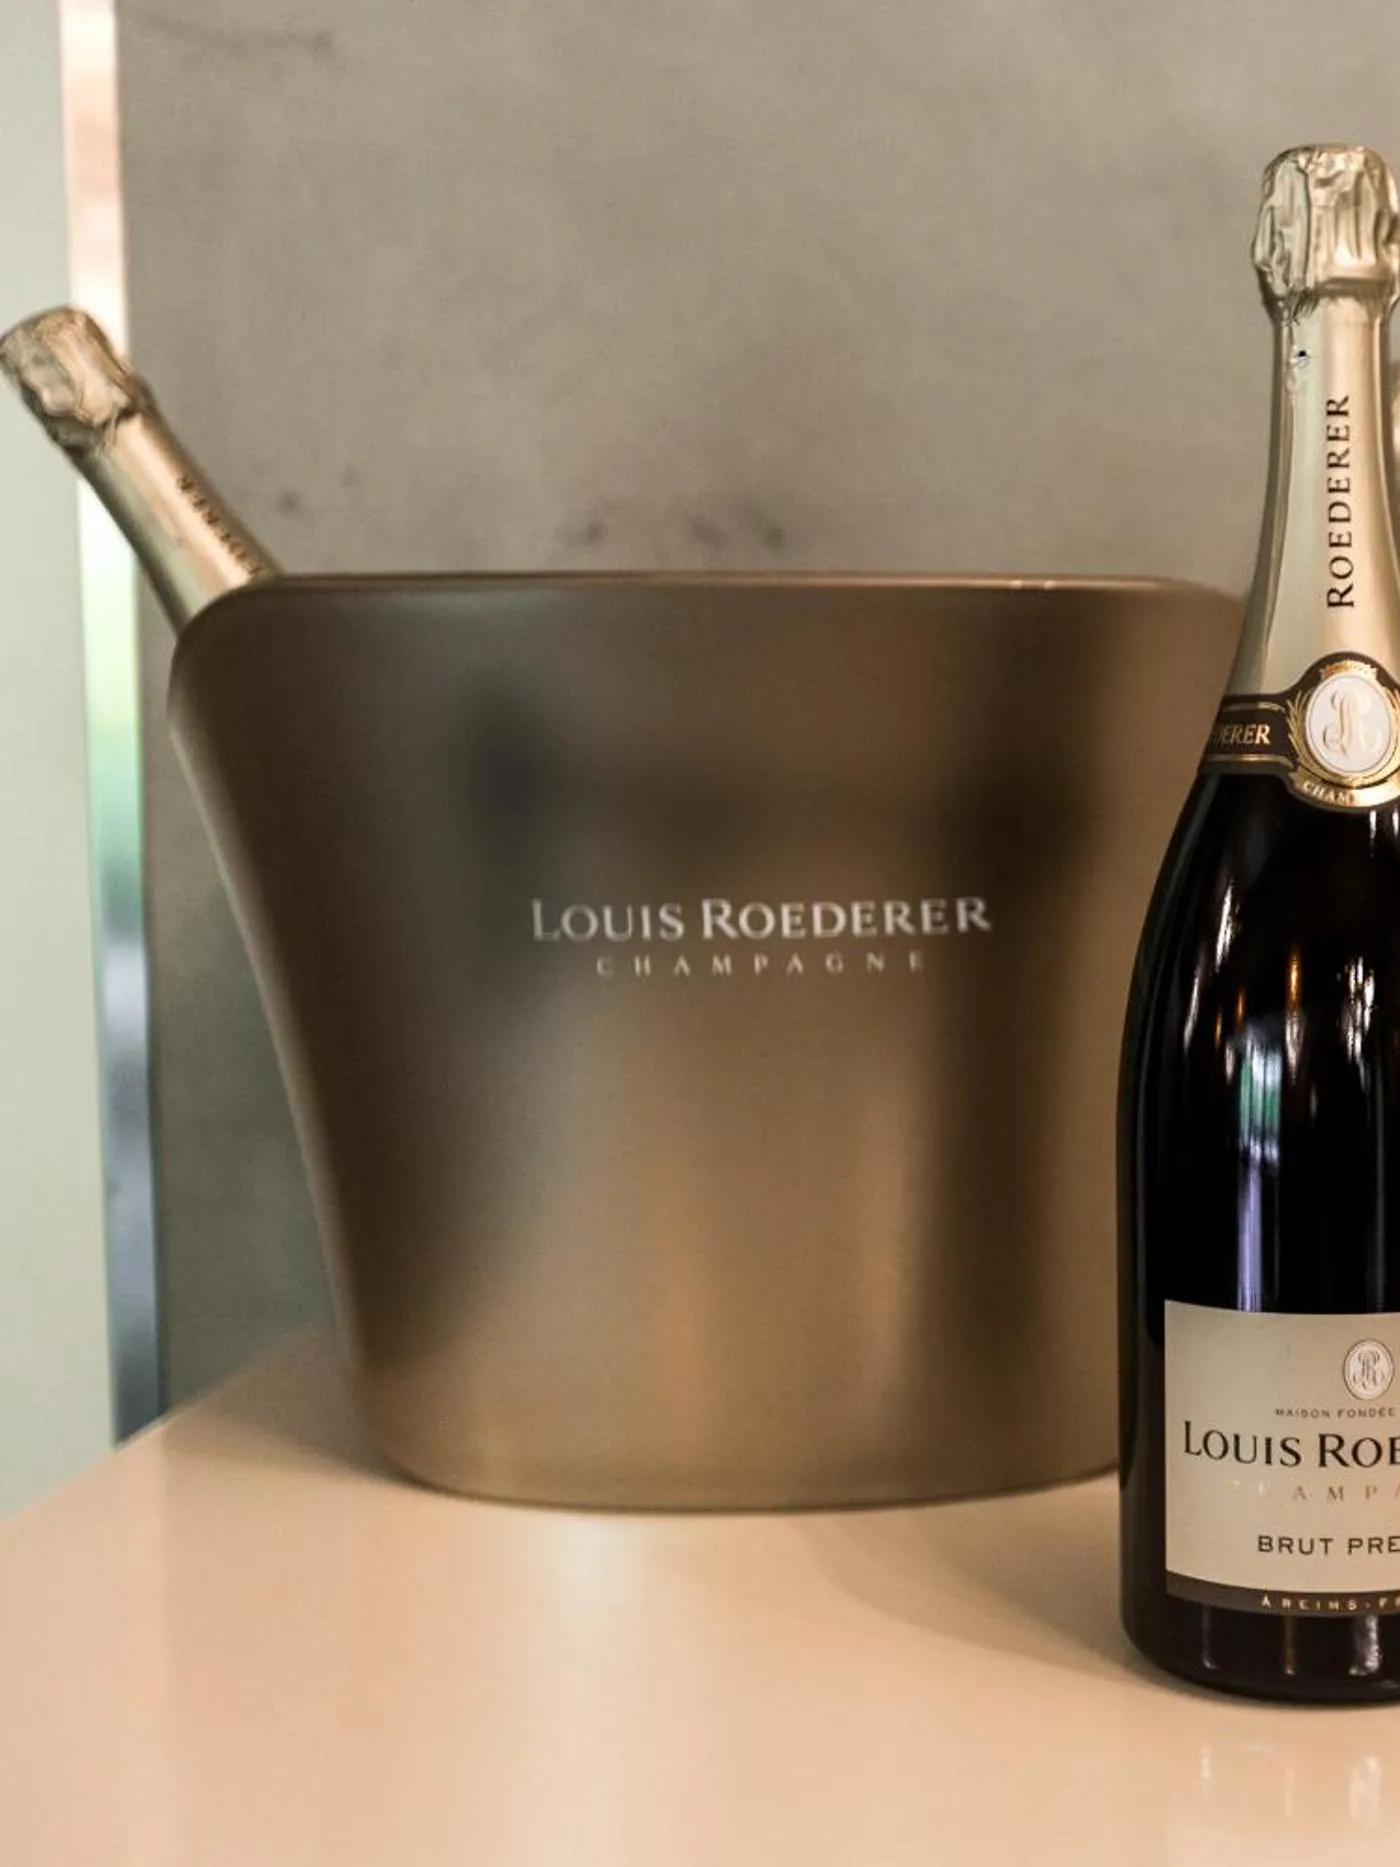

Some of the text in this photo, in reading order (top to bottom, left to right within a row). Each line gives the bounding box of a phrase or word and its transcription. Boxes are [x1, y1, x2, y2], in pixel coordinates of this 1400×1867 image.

[1326, 395, 1355, 608] ROEDERER
[531, 897, 993, 941] LOUIS ROEDERER
[595, 950, 926, 976] CHAMPAGNE
[1275, 1407, 1330, 1419] MAISON
[1183, 1420, 1302, 1468] LOUIS
[1257, 1534, 1334, 1556] BRUT
